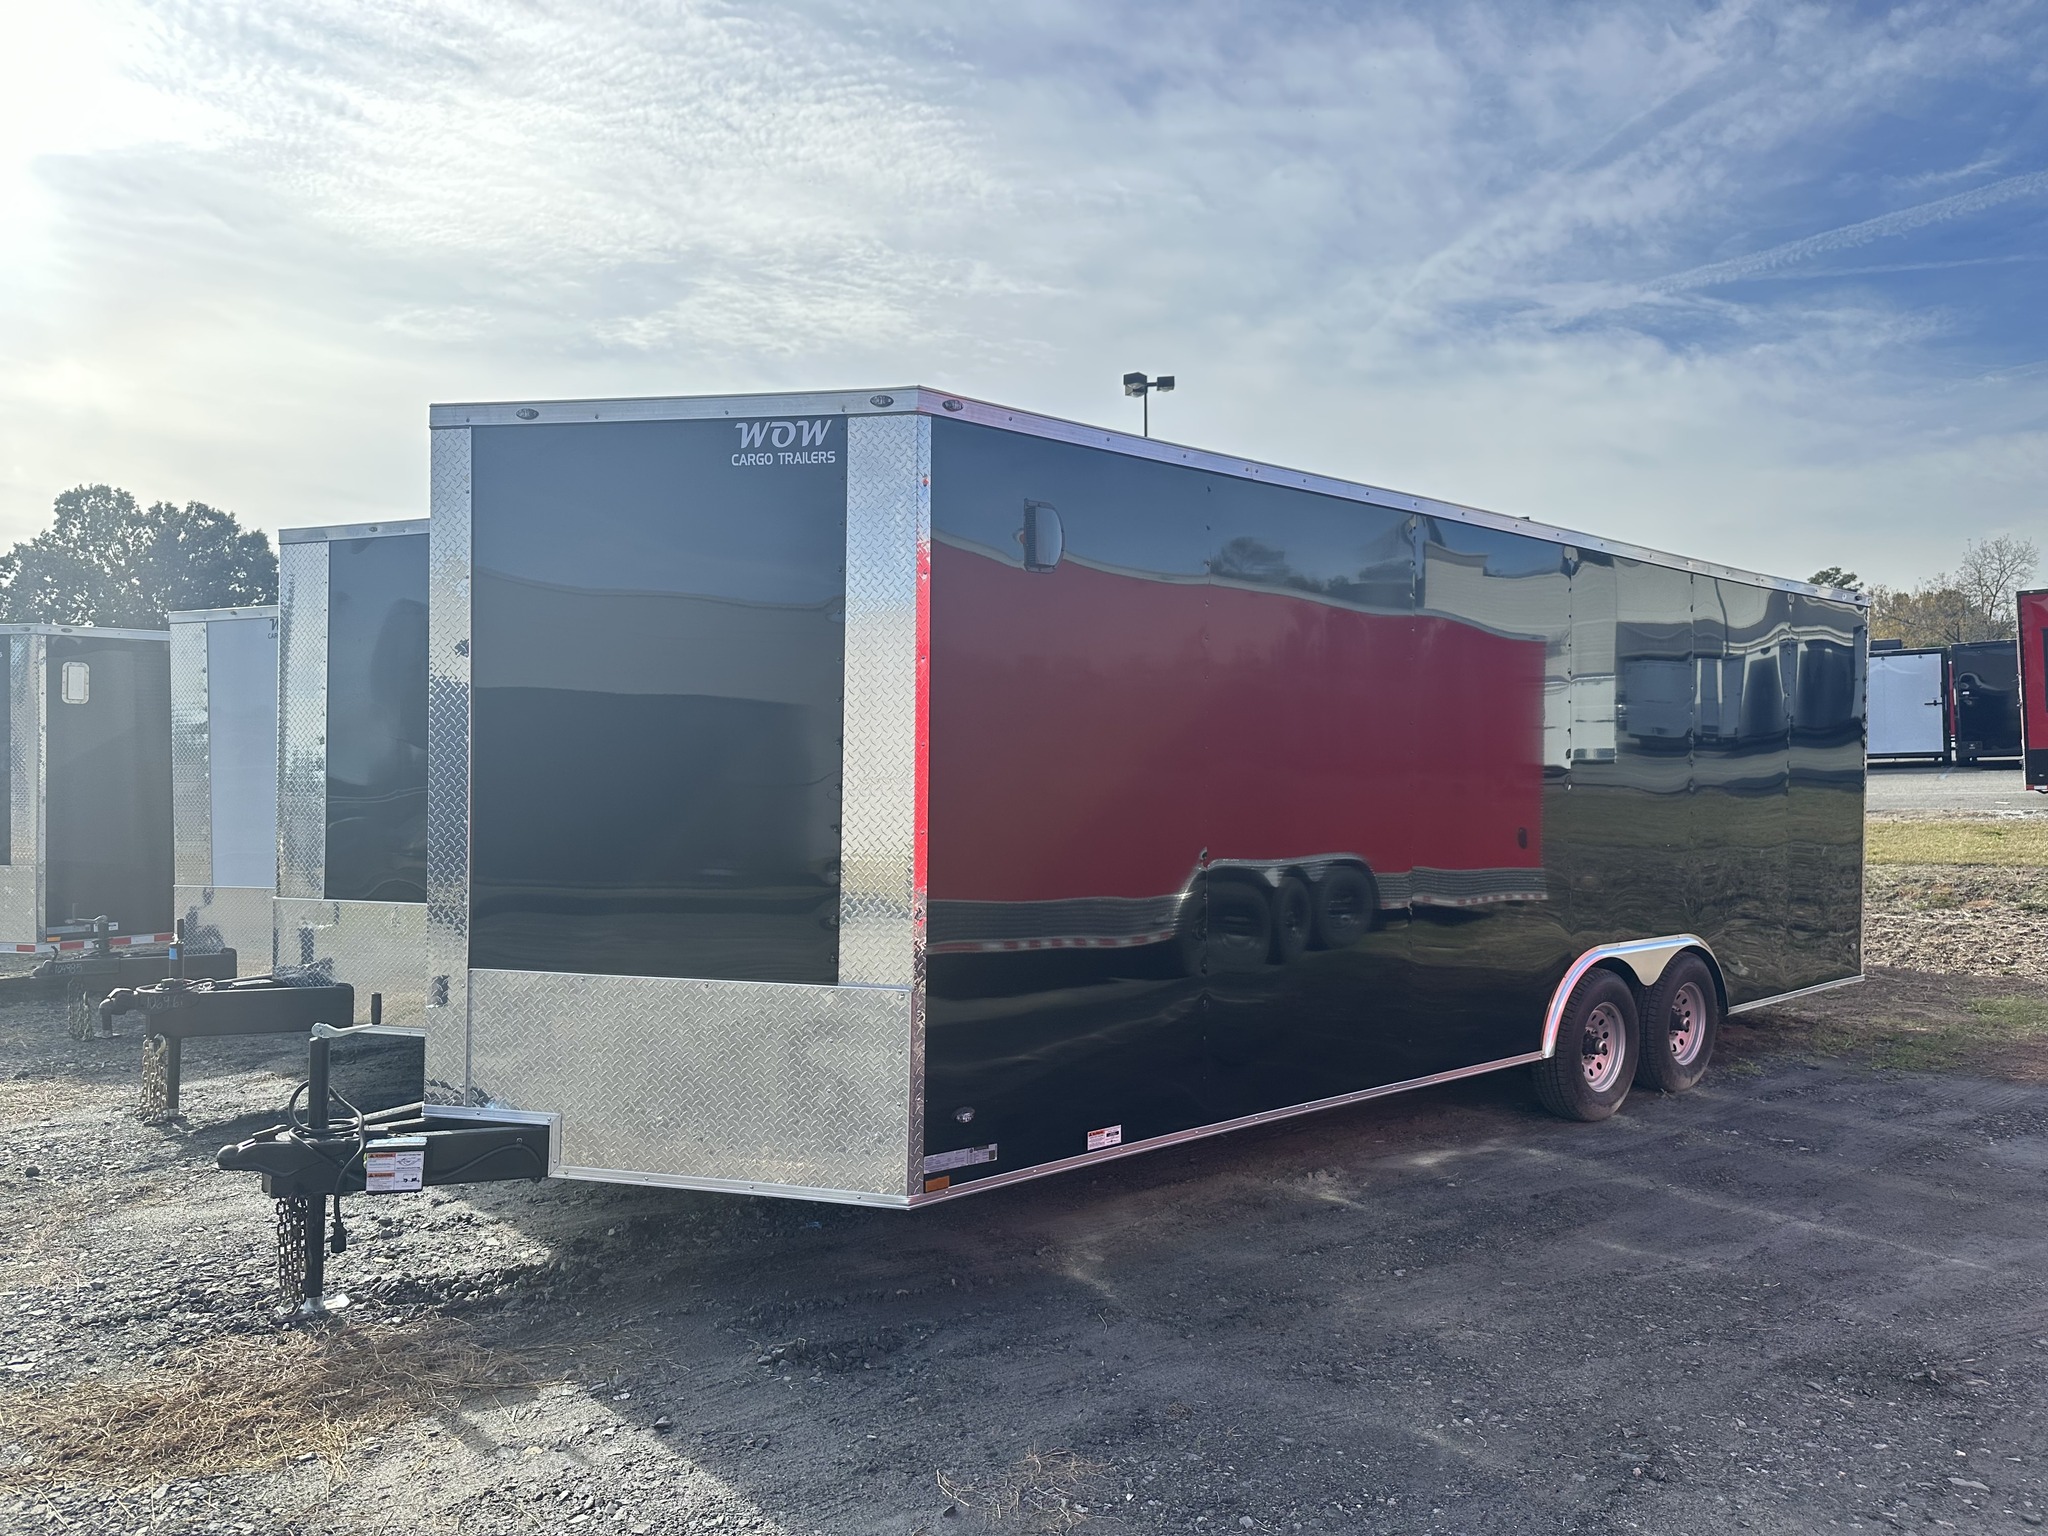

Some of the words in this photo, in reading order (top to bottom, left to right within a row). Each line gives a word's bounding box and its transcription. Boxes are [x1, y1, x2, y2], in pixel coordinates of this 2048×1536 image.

[735, 420, 832, 449] WOW
[731, 453, 774, 466] CARGO
[777, 451, 836, 465] TRAILERS
